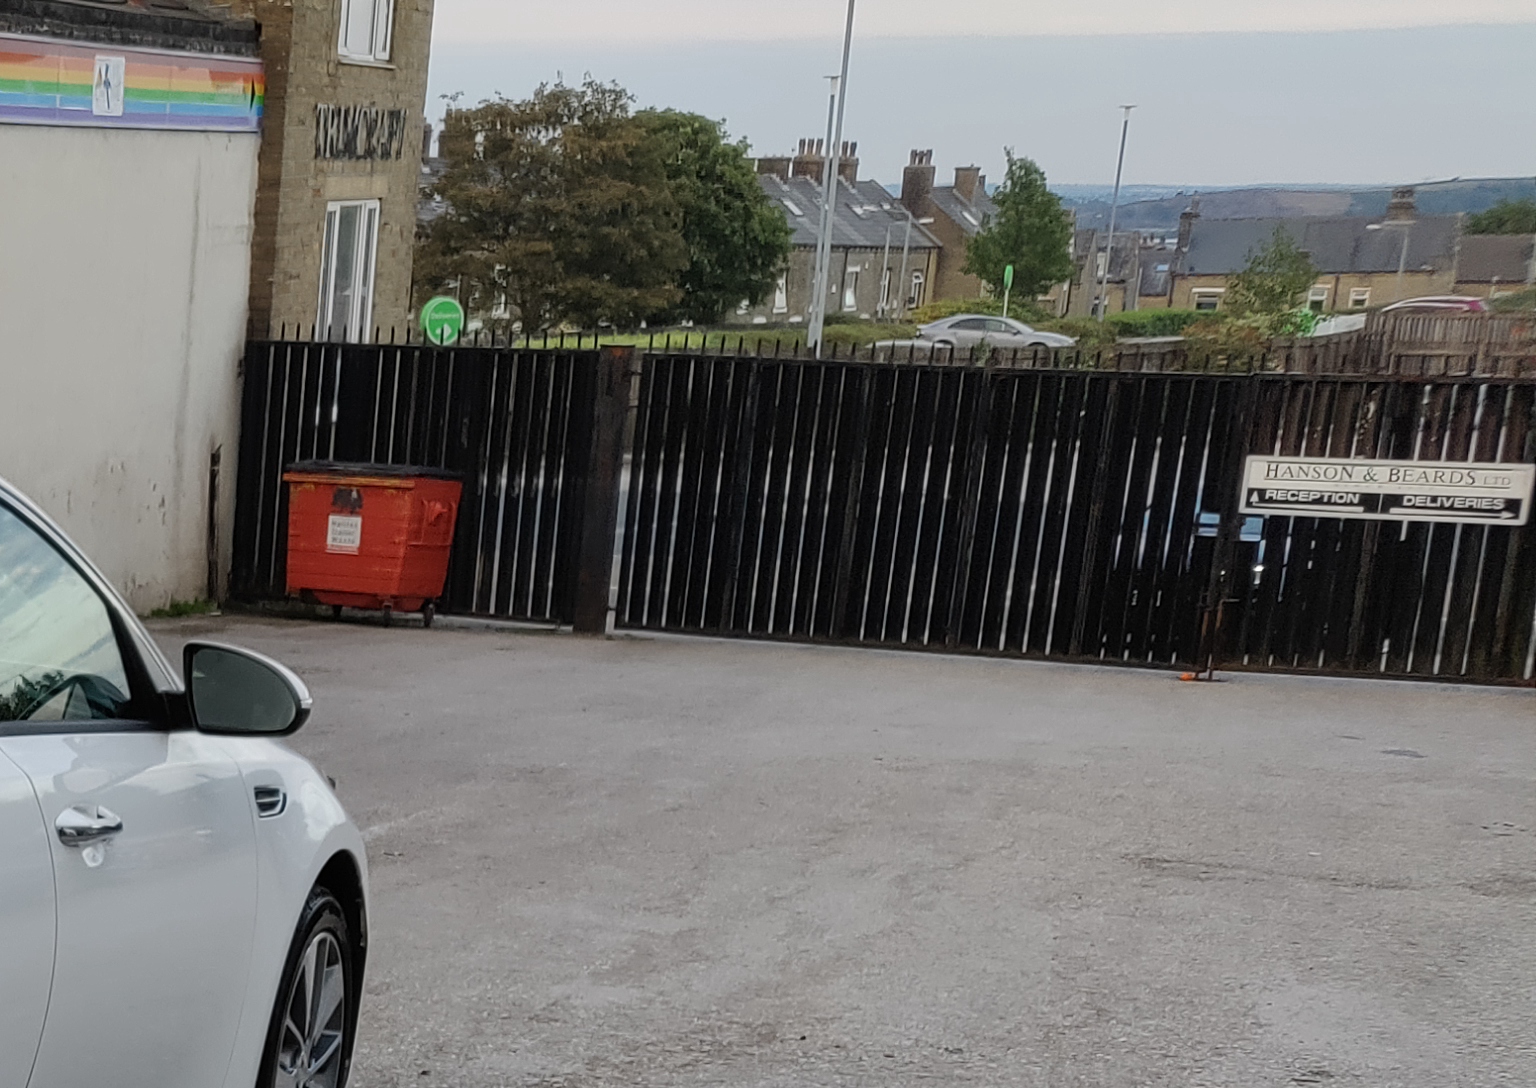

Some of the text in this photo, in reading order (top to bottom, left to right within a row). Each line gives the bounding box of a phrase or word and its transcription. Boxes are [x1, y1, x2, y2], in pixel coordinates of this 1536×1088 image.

[1265, 463, 1512, 486] HANSON & BEARDS LTD
[1264, 489, 1506, 511] RECEPTION DELIVERIES
